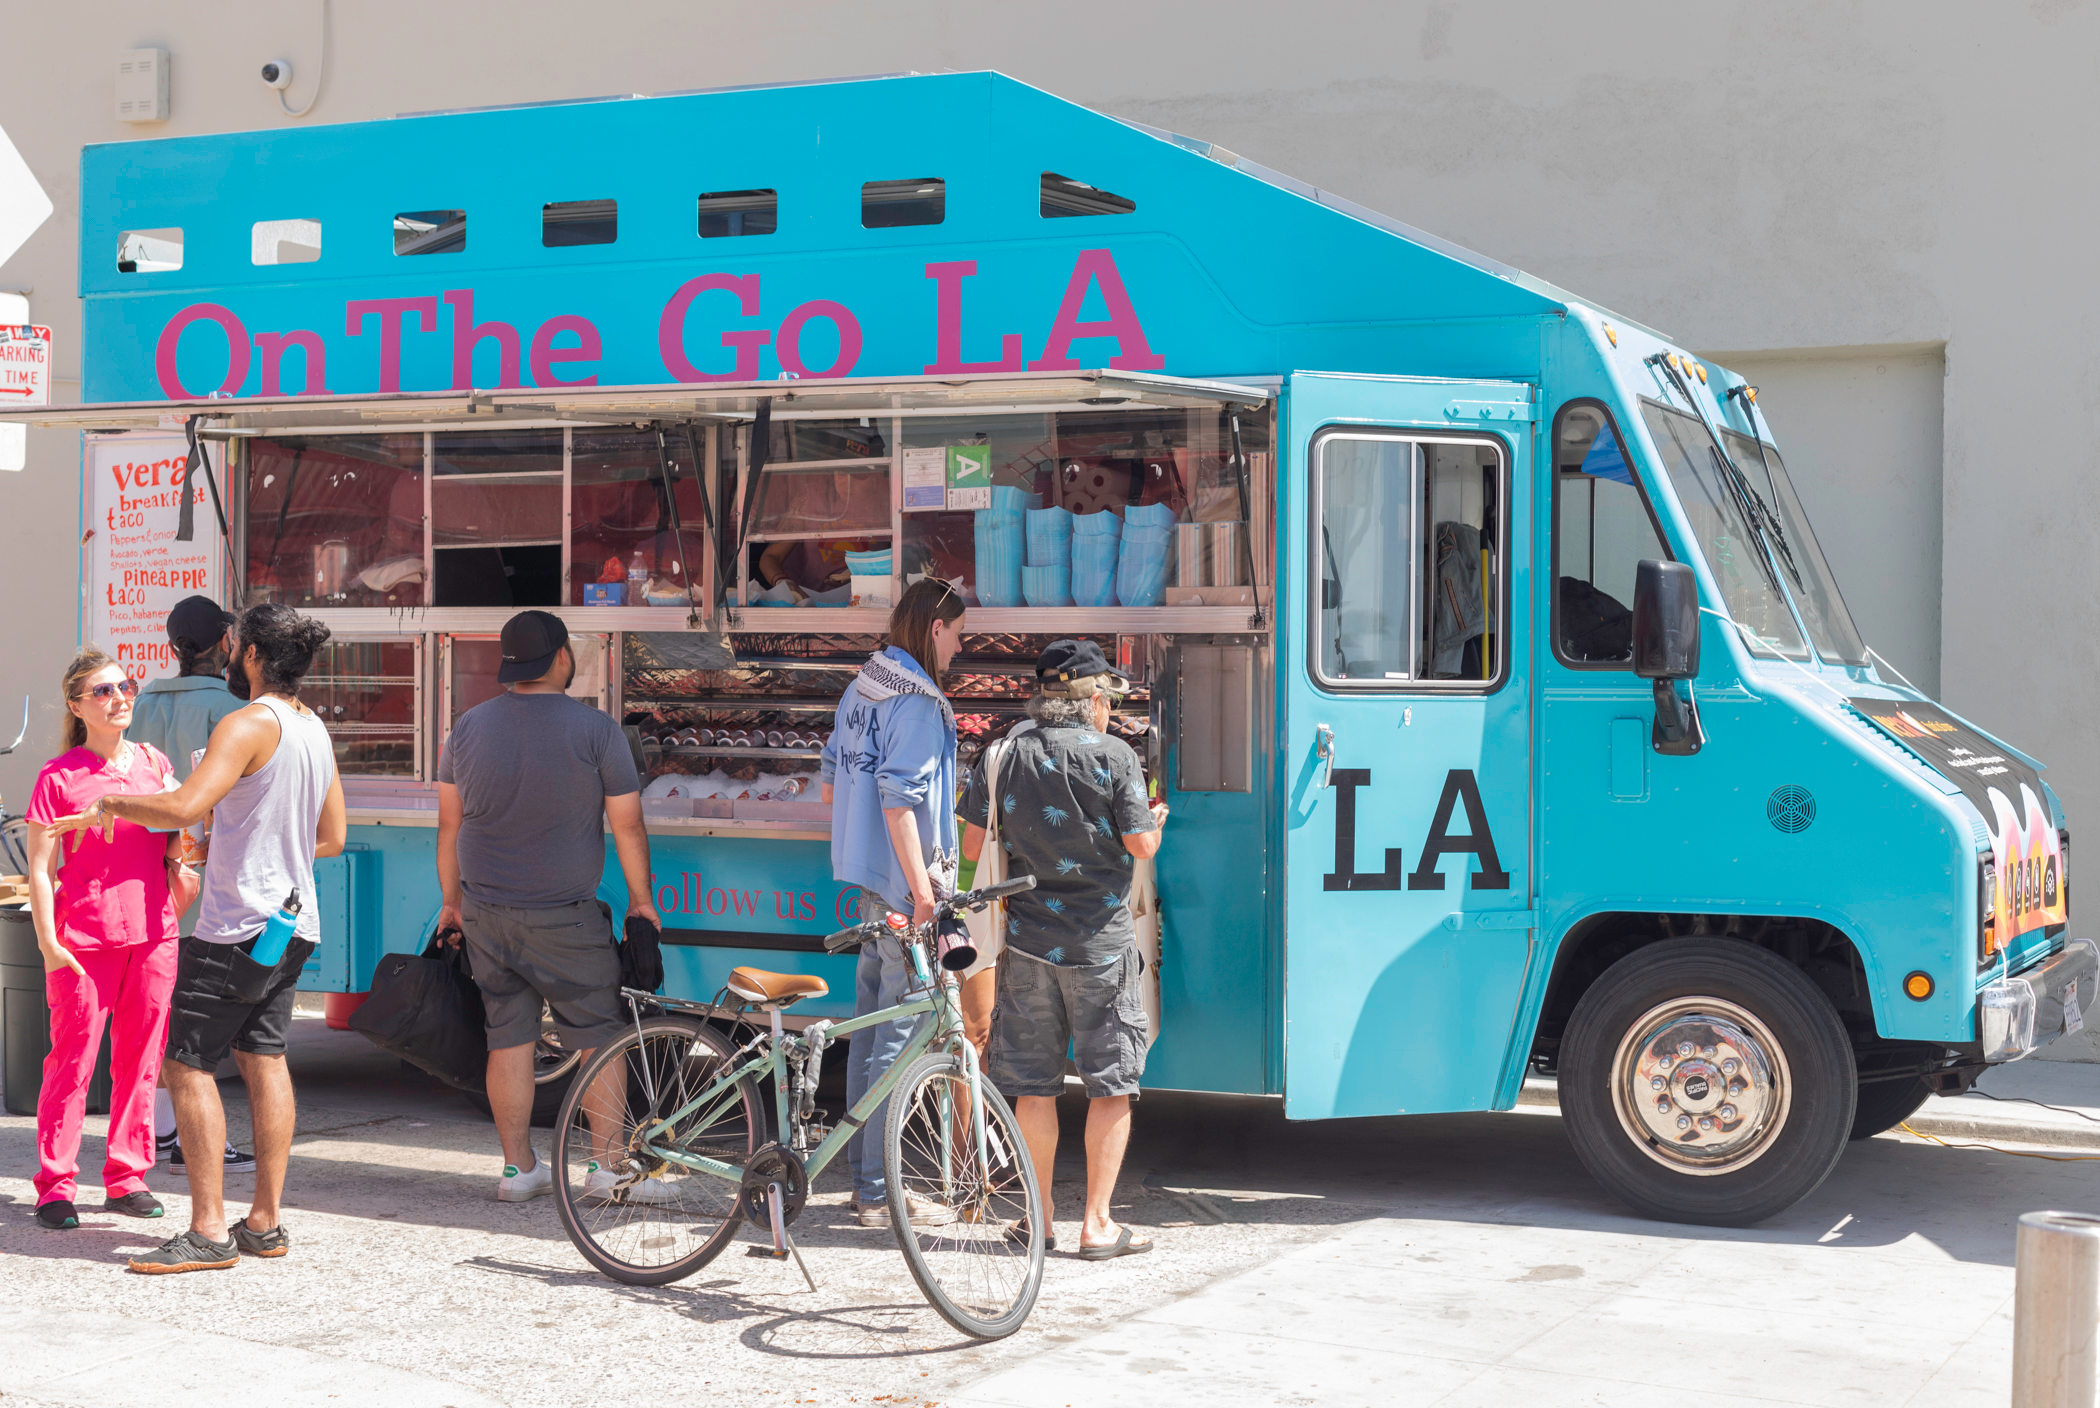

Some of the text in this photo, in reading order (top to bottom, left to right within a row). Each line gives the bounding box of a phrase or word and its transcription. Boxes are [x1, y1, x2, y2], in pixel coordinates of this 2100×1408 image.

[155, 248, 1166, 400] On The Go LA
[5, 369, 38, 384] TIME
[112, 455, 188, 492] vera
[956, 454, 980, 480] A
[107, 507, 144, 531] taco
[110, 533, 146, 547] Peppers
[142, 547, 169, 557] verde
[147, 558, 173, 570] vegan
[175, 555, 207, 565] cheese
[106, 582, 146, 606] taco
[1323, 768, 1510, 891] LA
[650, 871, 763, 917] ollow
[773, 890, 817, 921] us
